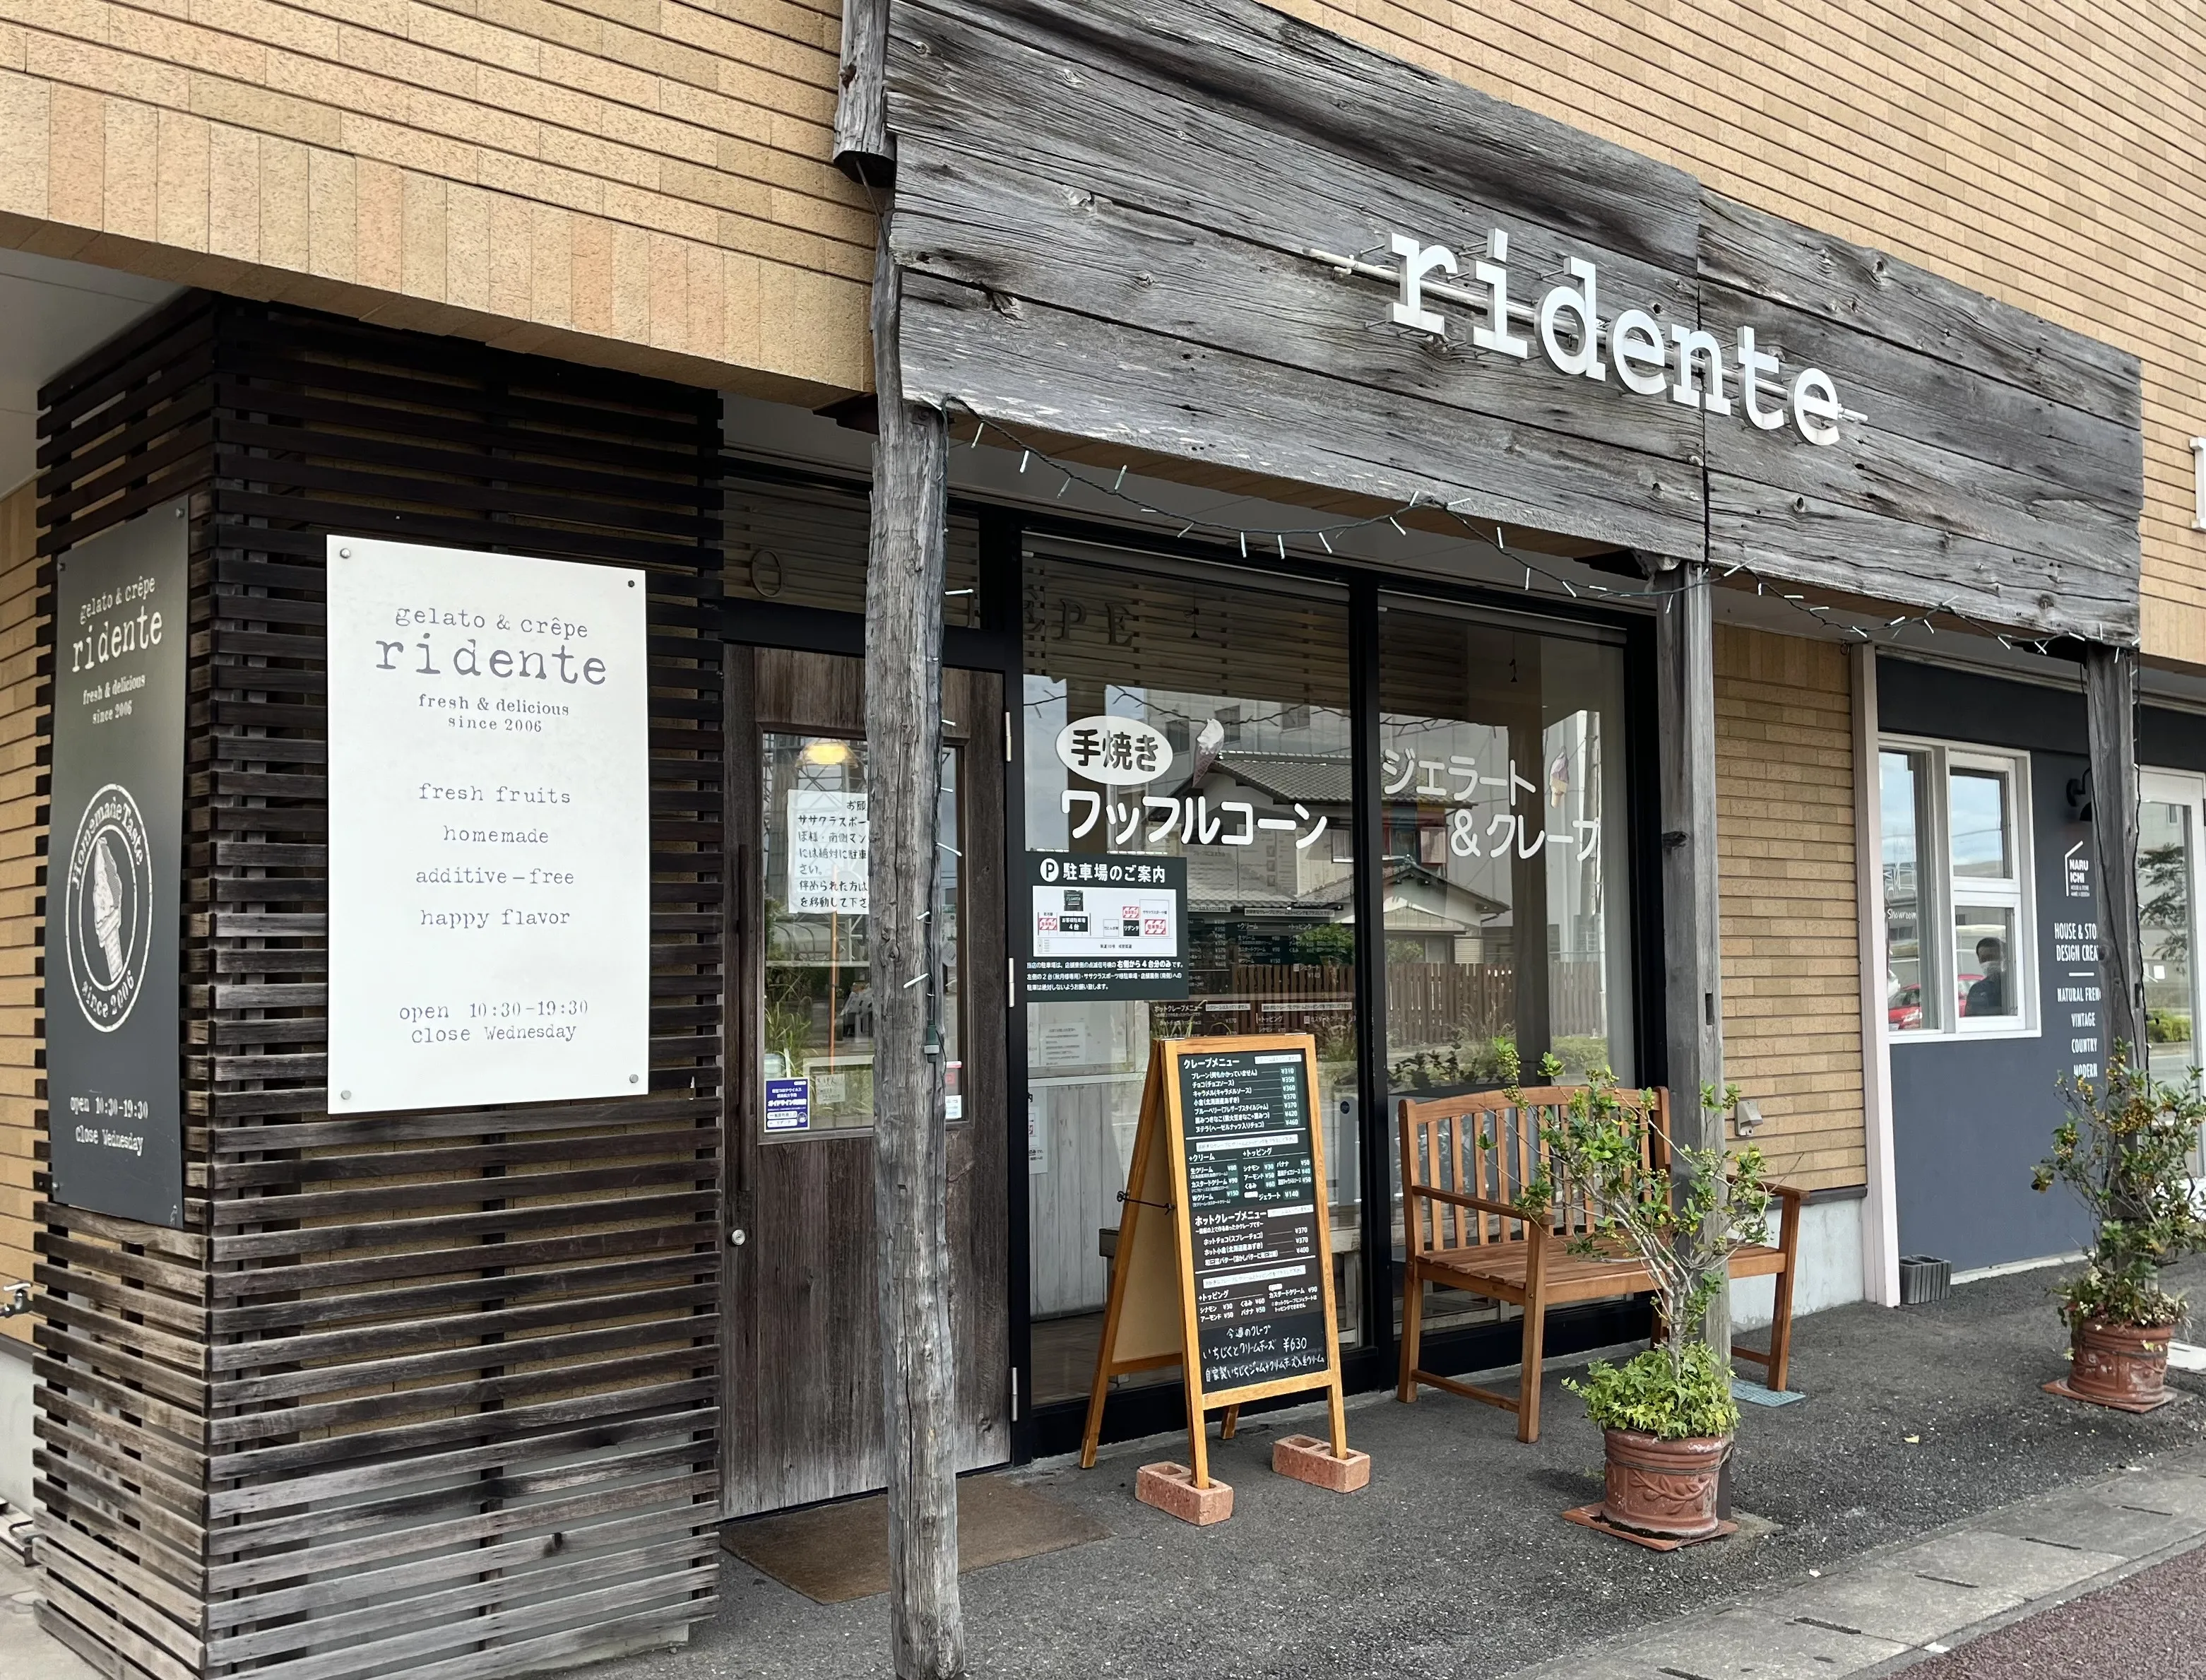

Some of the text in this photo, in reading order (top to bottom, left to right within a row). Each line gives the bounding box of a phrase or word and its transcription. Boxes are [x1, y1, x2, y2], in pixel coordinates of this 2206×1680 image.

[1384, 227, 1840, 446] ridente
[80, 575, 155, 625] gelato & crêpe
[395, 608, 588, 640] gelato & crêpe
[72, 605, 162, 673] ridente
[375, 633, 607, 685] ridente
[83, 674, 146, 705] fresh & delicious
[93, 699, 133, 724] since 2006
[418, 694, 569, 716] fresh & delicious
[448, 716, 542, 733] since 2006
[1071, 728, 1159, 771] 手焼き
[1382, 748, 1536, 806] ジェラート
[419, 783, 571, 804] fresh fruits
[1061, 789, 1327, 849] ワッフルコーン
[444, 825, 549, 844] homemade
[1062, 862, 1166, 883] 駐車場のご案内
[2069, 859, 2089, 870] NARU
[2070, 872, 2085, 883] ICHI
[420, 909, 571, 929] happy flavor
[2054, 923, 2098, 940] HOUSE & STO
[2056, 945, 2099, 962] DESIGN CREA
[111, 969, 134, 1015] 2006
[2057, 988, 2084, 1002] NATURAL
[399, 1000, 588, 1022] open 10:30-19:30
[2071, 1012, 2096, 1027] VINTAGE
[485, 1024, 577, 1042] Wednesday
[2071, 1038, 2097, 1053] COUNTRY
[1184, 1057, 1240, 1069] クレープメニュー
[2073, 1063, 2097, 1078] MODERN
[70, 1096, 148, 1119] open 10:30-19:30
[102, 1129, 143, 1157] Wednesday
[1194, 1211, 1267, 1226] ホットクレープメニュー
[1283, 1337, 1307, 1352] ¥630
